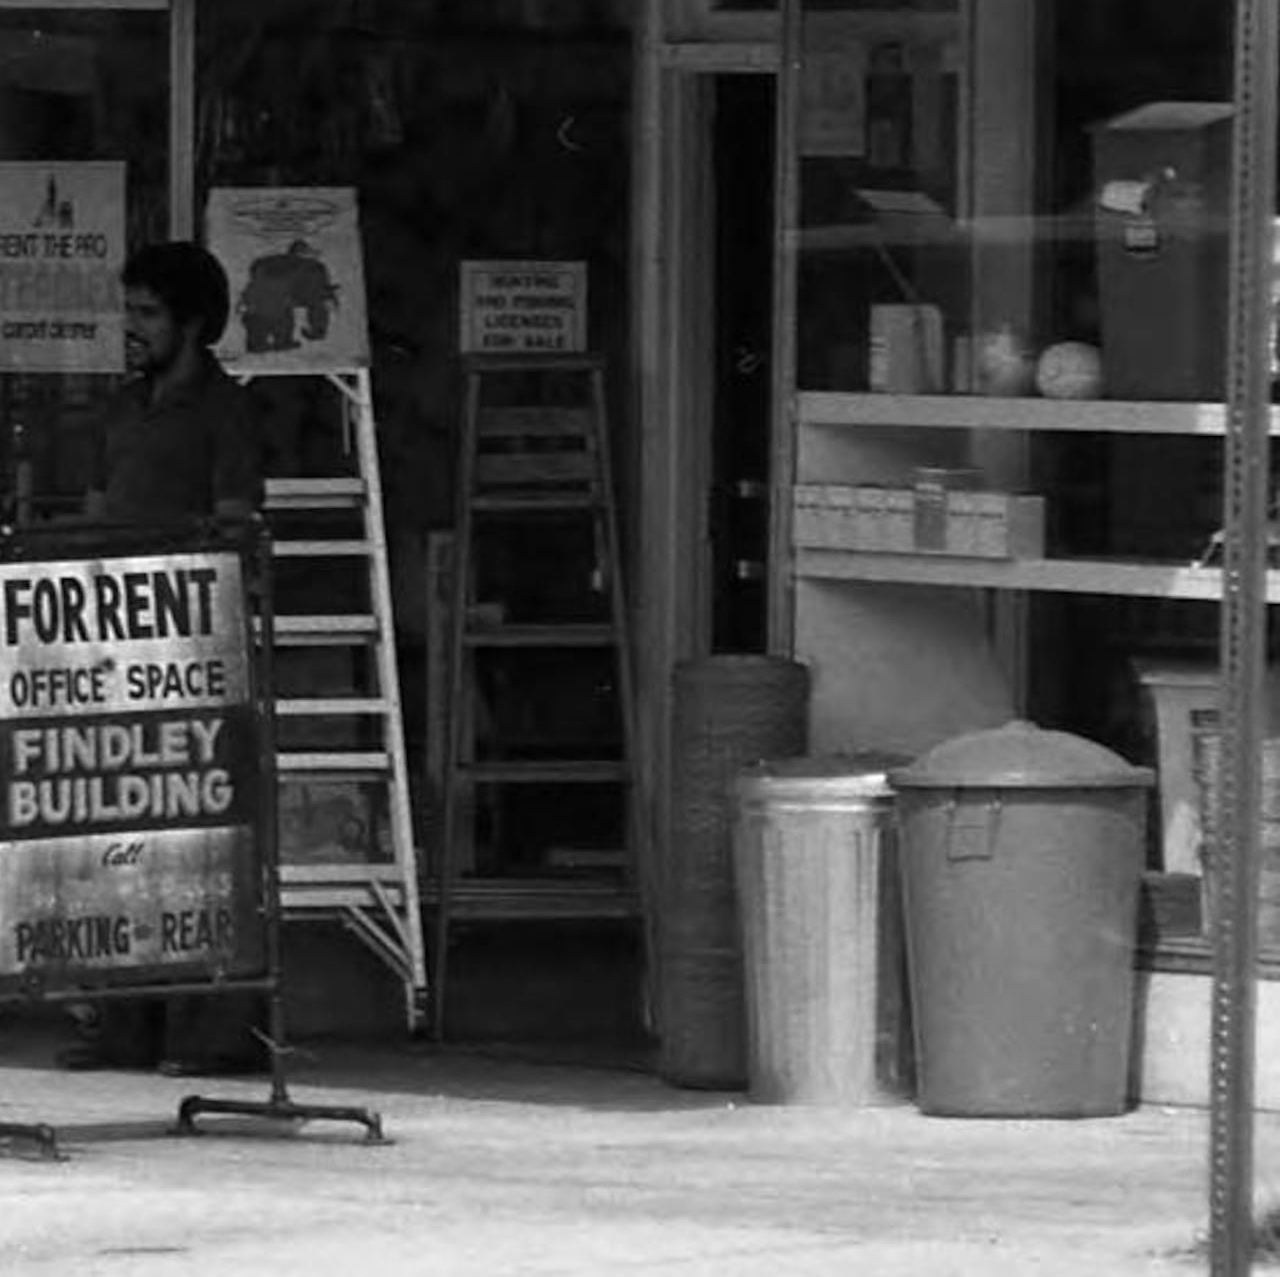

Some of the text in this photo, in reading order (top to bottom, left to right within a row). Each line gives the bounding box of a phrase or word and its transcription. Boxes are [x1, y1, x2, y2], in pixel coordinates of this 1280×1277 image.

[2, 567, 218, 646] FOR RENT
[10, 660, 226, 708] OFFICE SPACE
[12, 719, 224, 774] FINDLEY
[8, 768, 236, 826] BUILDING
[101, 842, 146, 868] Call
[16, 909, 236, 963] PARKING REAR
